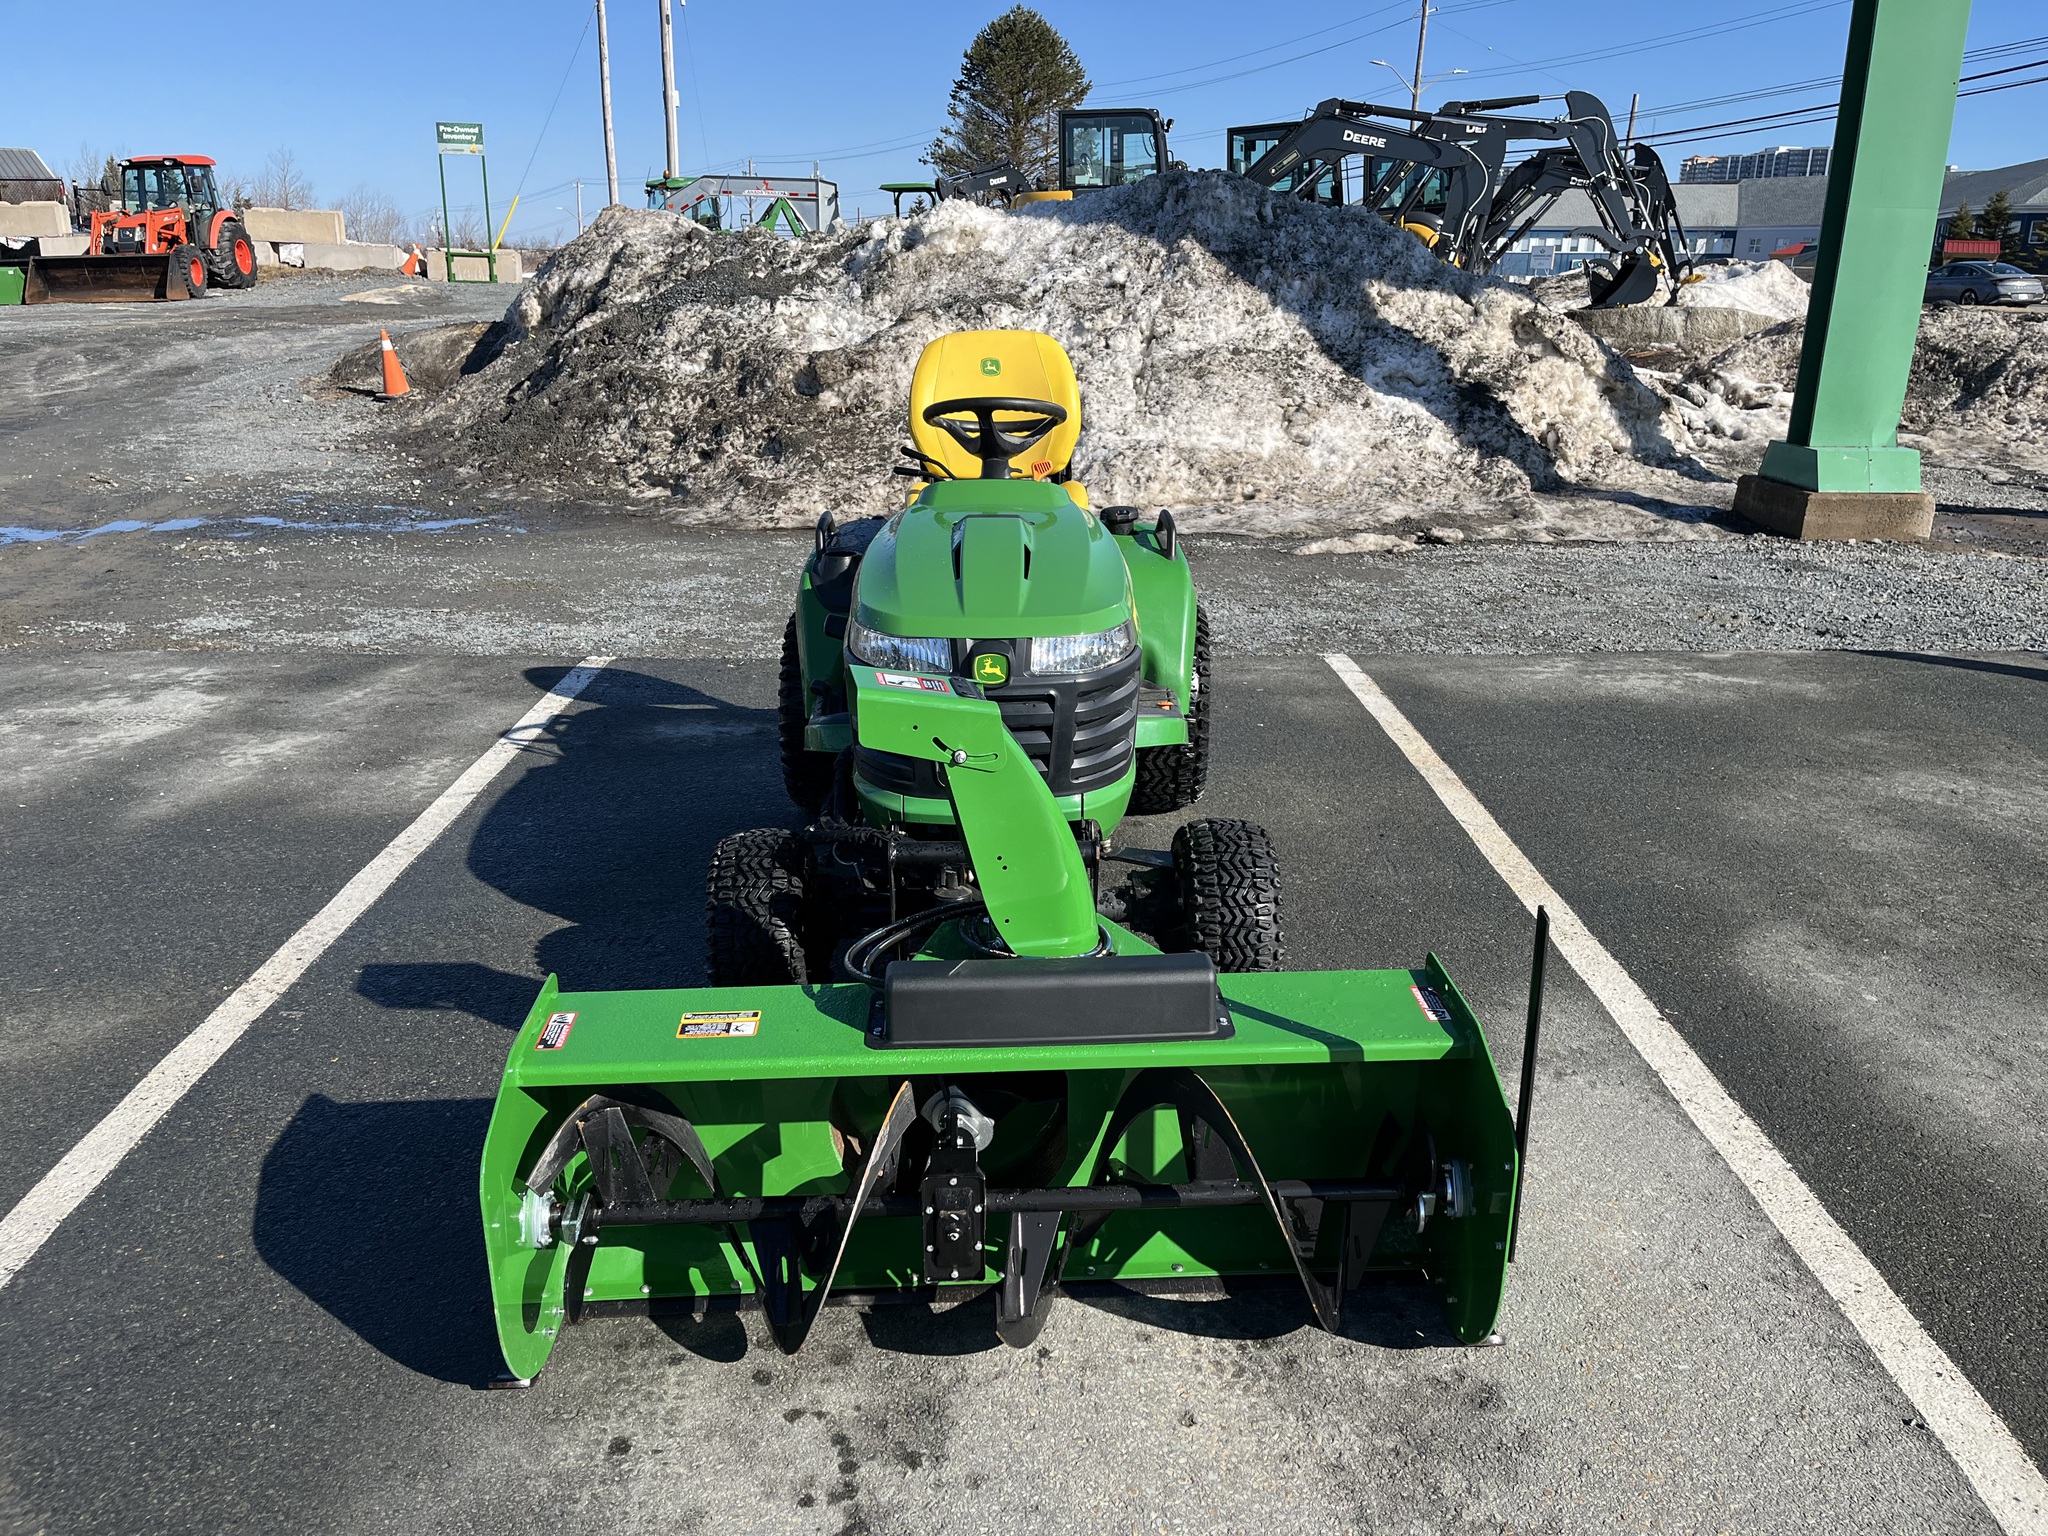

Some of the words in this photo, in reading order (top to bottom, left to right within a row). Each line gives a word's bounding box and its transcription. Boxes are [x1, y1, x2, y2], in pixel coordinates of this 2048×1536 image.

[439, 125, 479, 133] Pre-Owned
[443, 132, 477, 142] Inventory
[1342, 129, 1387, 148] DEERE
